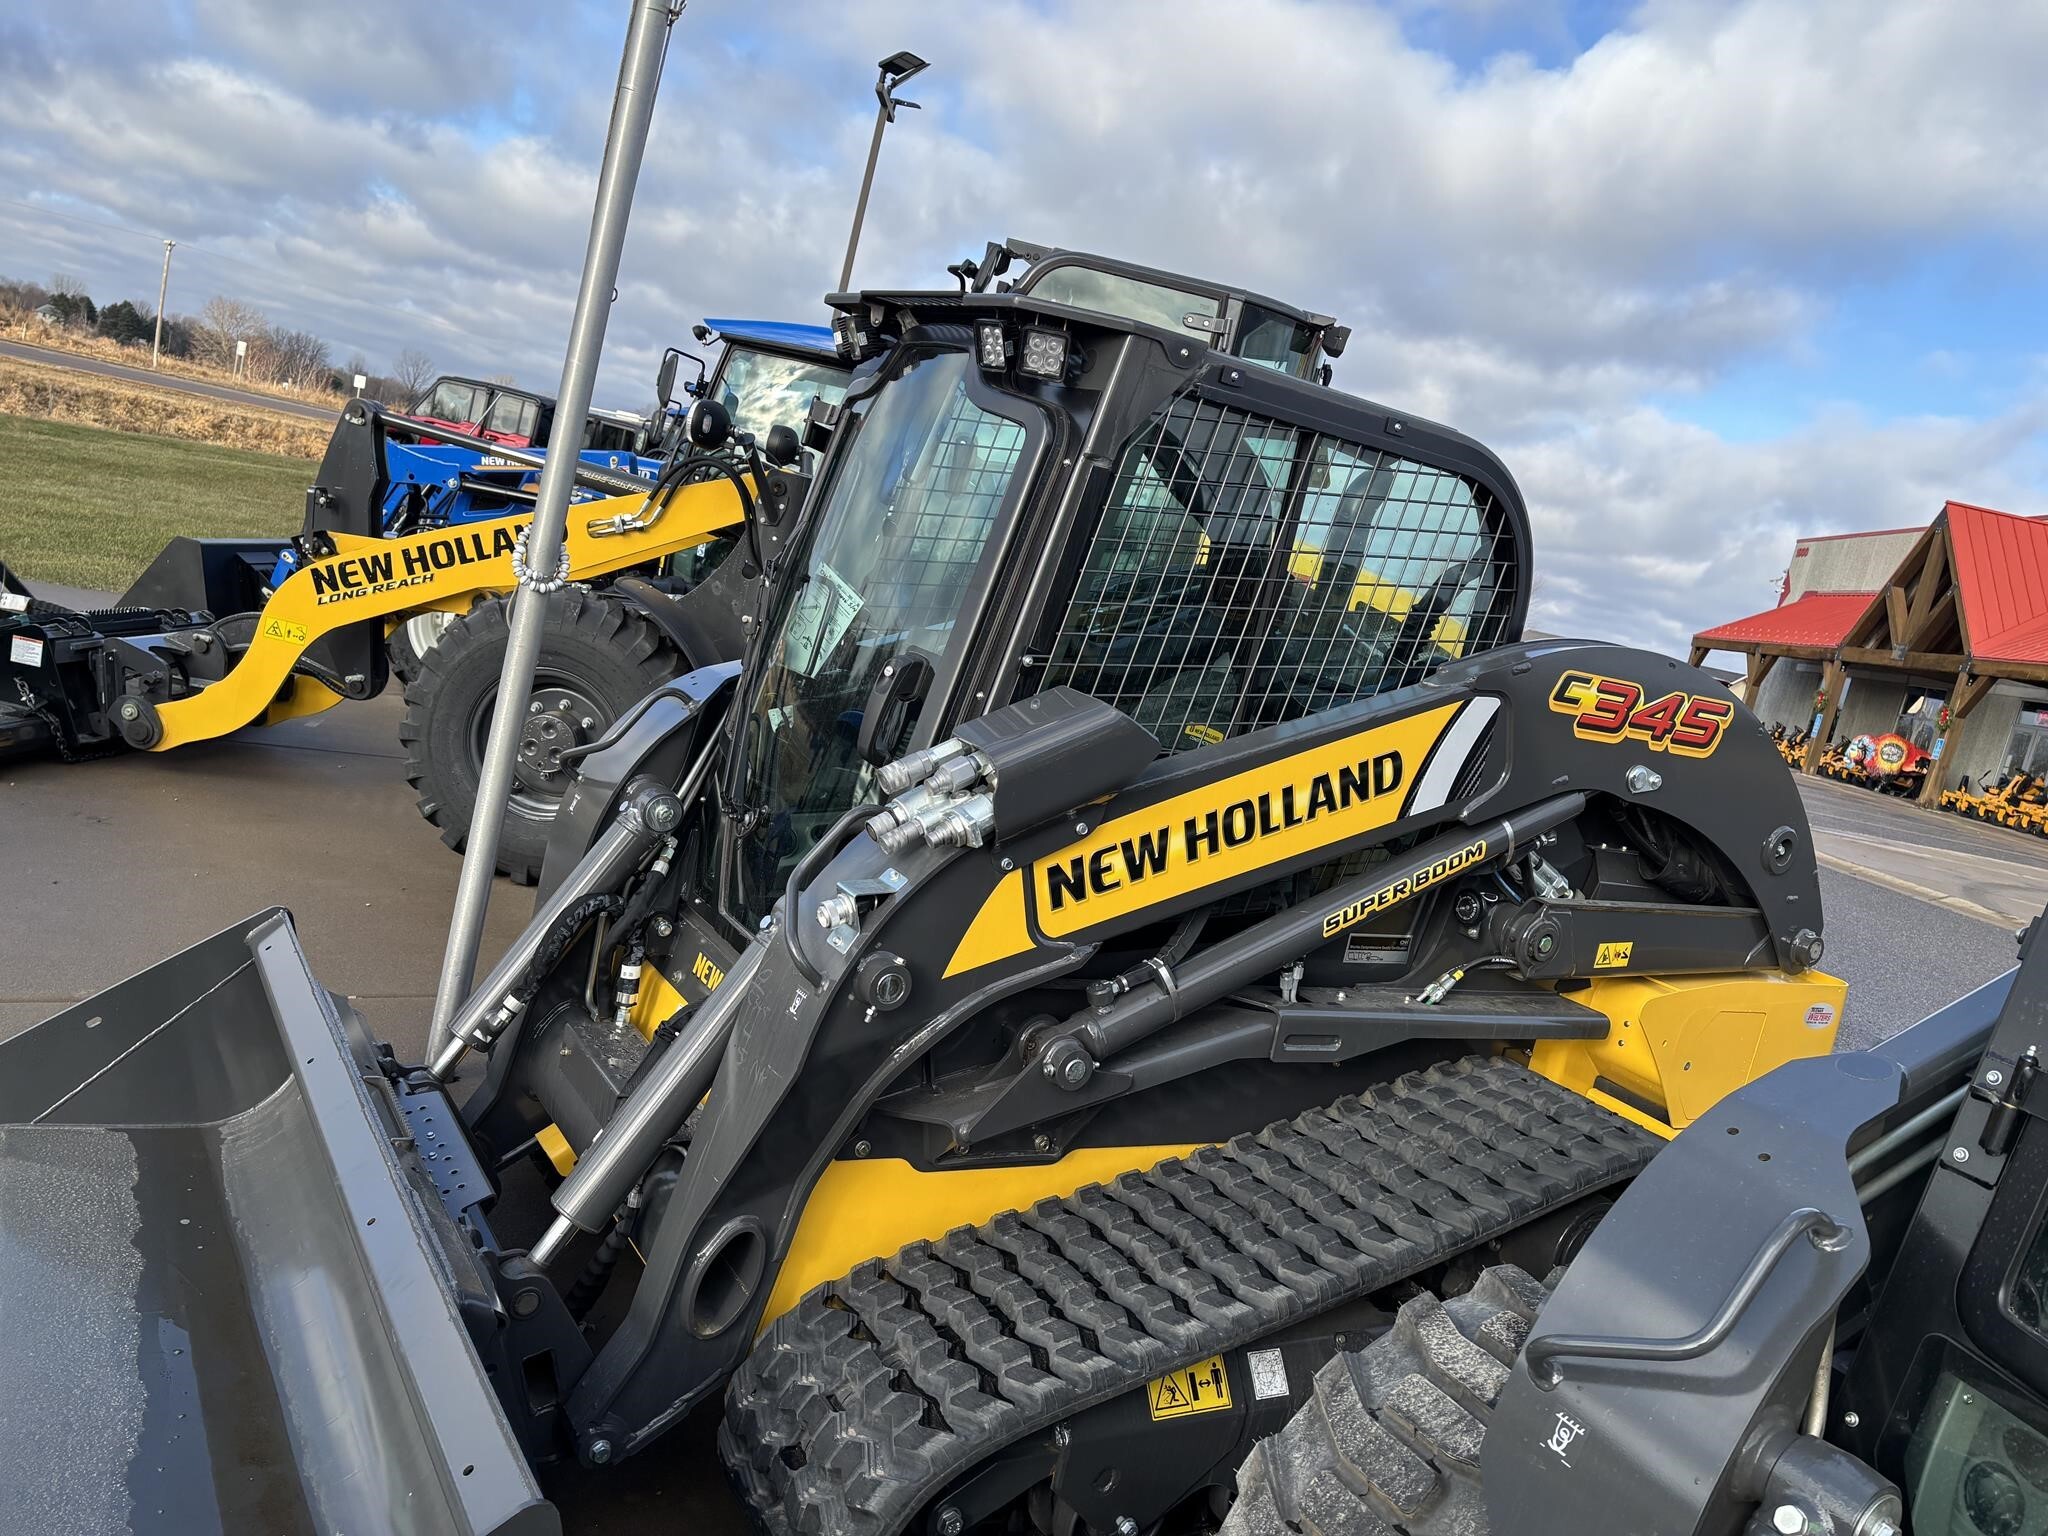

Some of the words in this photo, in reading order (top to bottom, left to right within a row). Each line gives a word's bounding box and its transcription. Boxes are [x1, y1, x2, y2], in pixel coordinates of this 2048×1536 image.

[481, 456, 505, 466] NEW
[310, 551, 394, 595] NEW
[401, 521, 569, 576] HOLLA
[317, 588, 368, 606] LONG
[371, 572, 435, 594] REACH
[1046, 824, 1171, 913] NEW
[1183, 749, 1404, 864] HOLLAND
[1322, 878, 1412, 939] SUPER
[1412, 839, 1488, 894] BOOM
[691, 951, 725, 992] NEW
